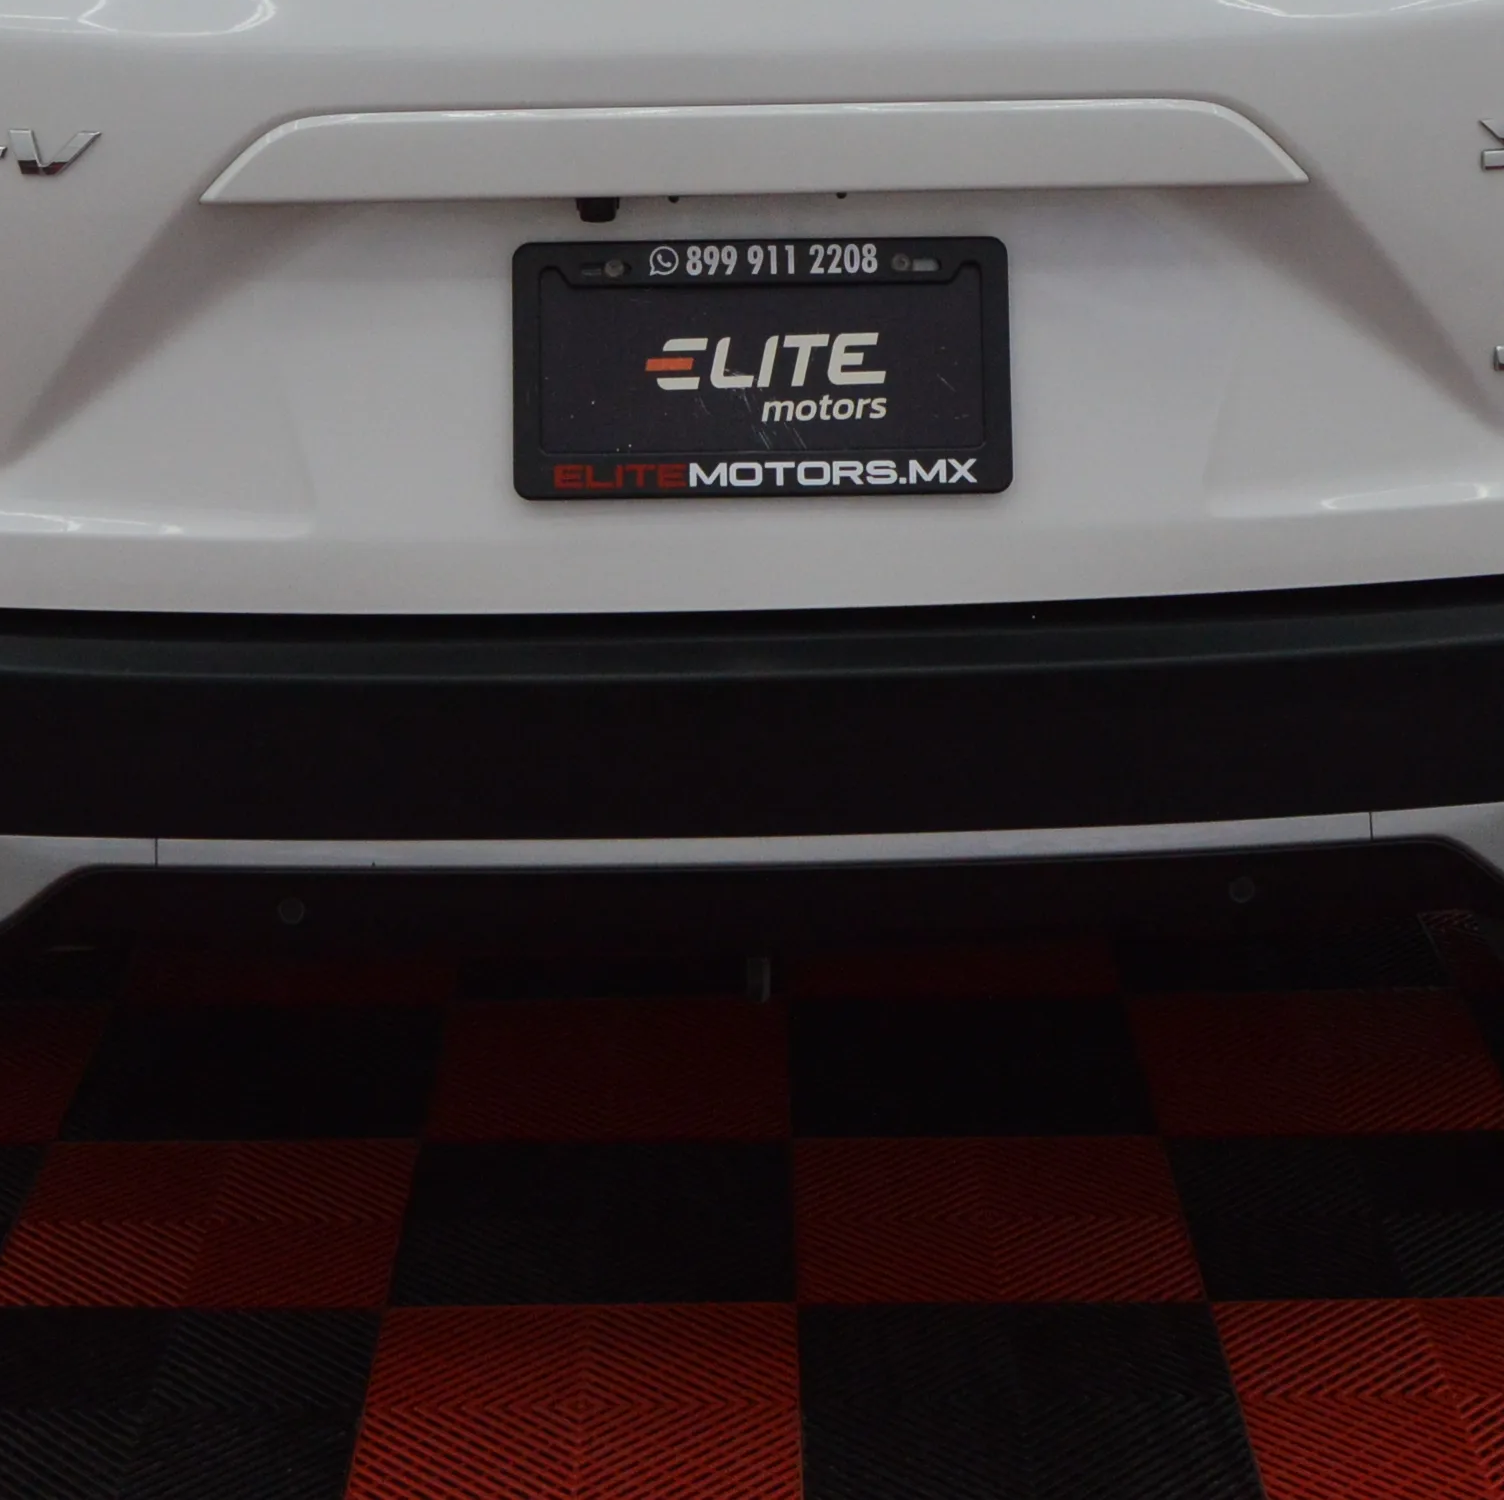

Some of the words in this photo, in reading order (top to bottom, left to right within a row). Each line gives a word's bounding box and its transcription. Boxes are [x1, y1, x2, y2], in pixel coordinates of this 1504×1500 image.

[686, 245, 737, 277] 899
[747, 244, 796, 276] 911
[809, 243, 879, 275] 2208
[644, 331, 887, 391] ELITE
[760, 396, 888, 423] motors
[552, 458, 979, 490] ELITEMOTORS.MX
